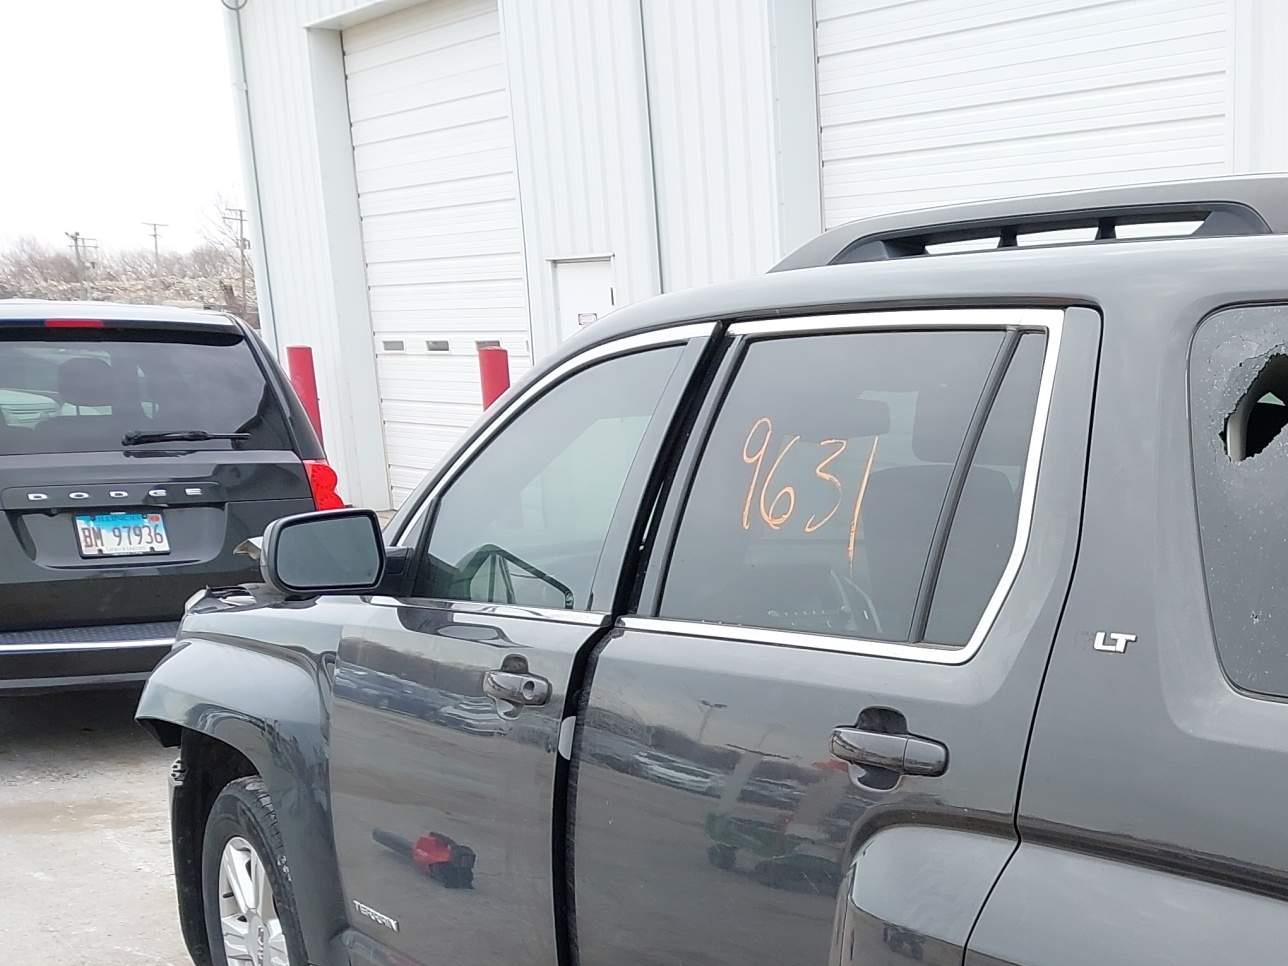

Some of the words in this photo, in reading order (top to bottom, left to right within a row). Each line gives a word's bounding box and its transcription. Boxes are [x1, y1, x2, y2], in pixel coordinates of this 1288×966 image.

[27, 487, 202, 501] DODGE
[742, 417, 879, 568] 9631
[81, 526, 104, 548] BM
[112, 524, 164, 547] 97936
[1093, 631, 1137, 654] LT
